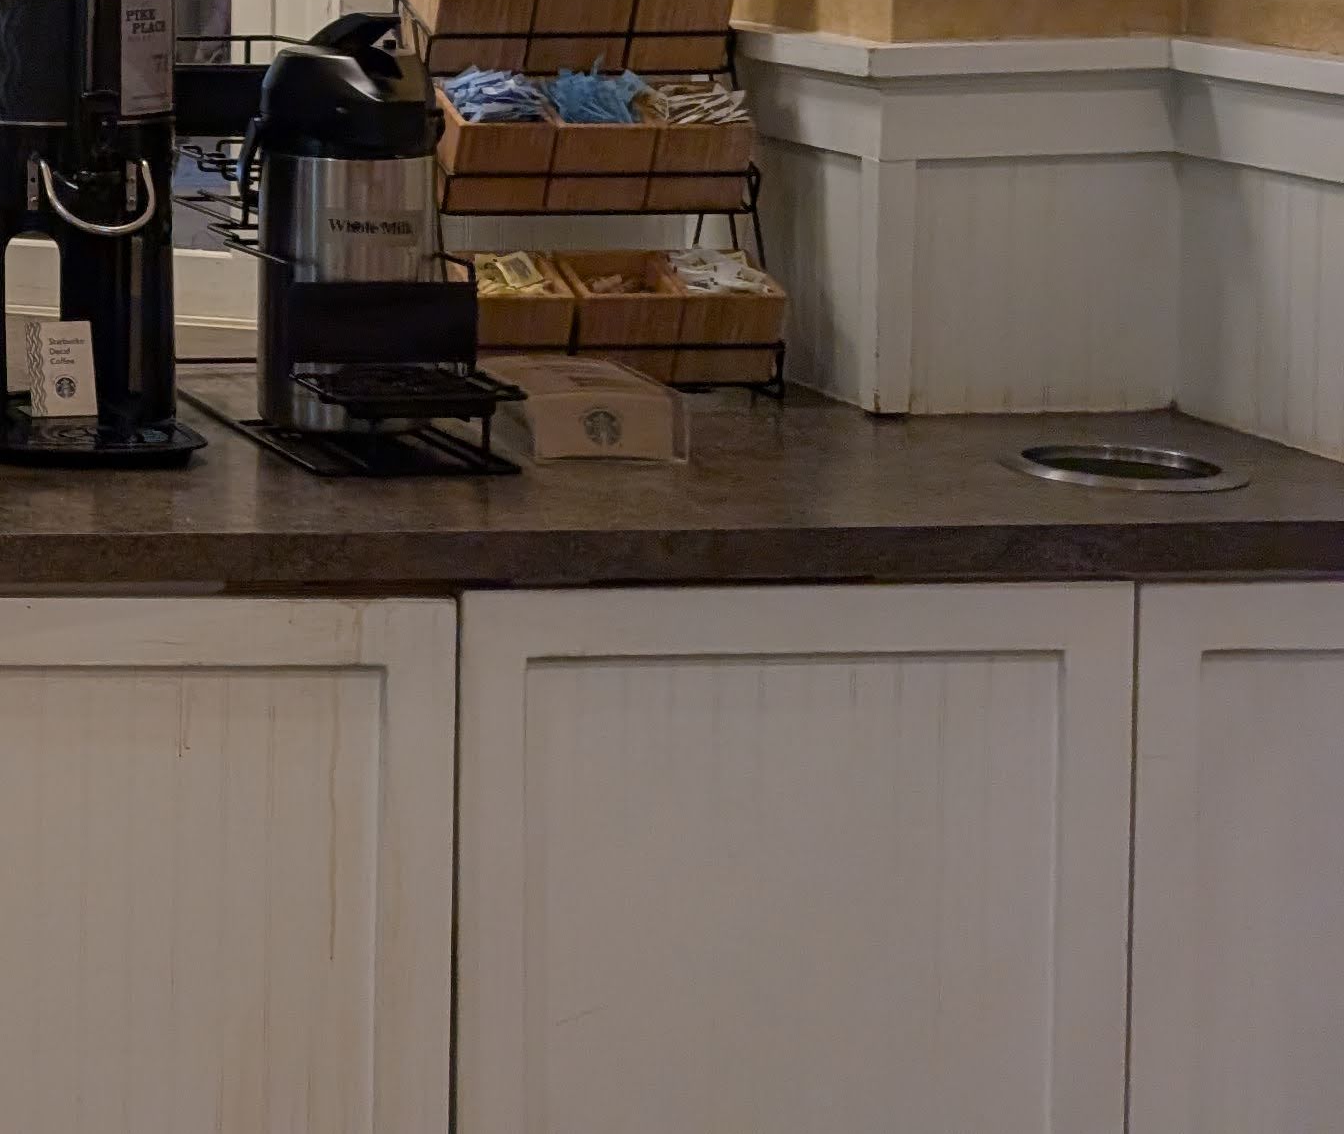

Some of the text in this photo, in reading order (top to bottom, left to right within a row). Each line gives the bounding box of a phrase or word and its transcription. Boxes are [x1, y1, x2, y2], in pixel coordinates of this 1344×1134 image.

[328, 218, 413, 235] Whole Milk
[50, 356, 75, 365] Coffee
